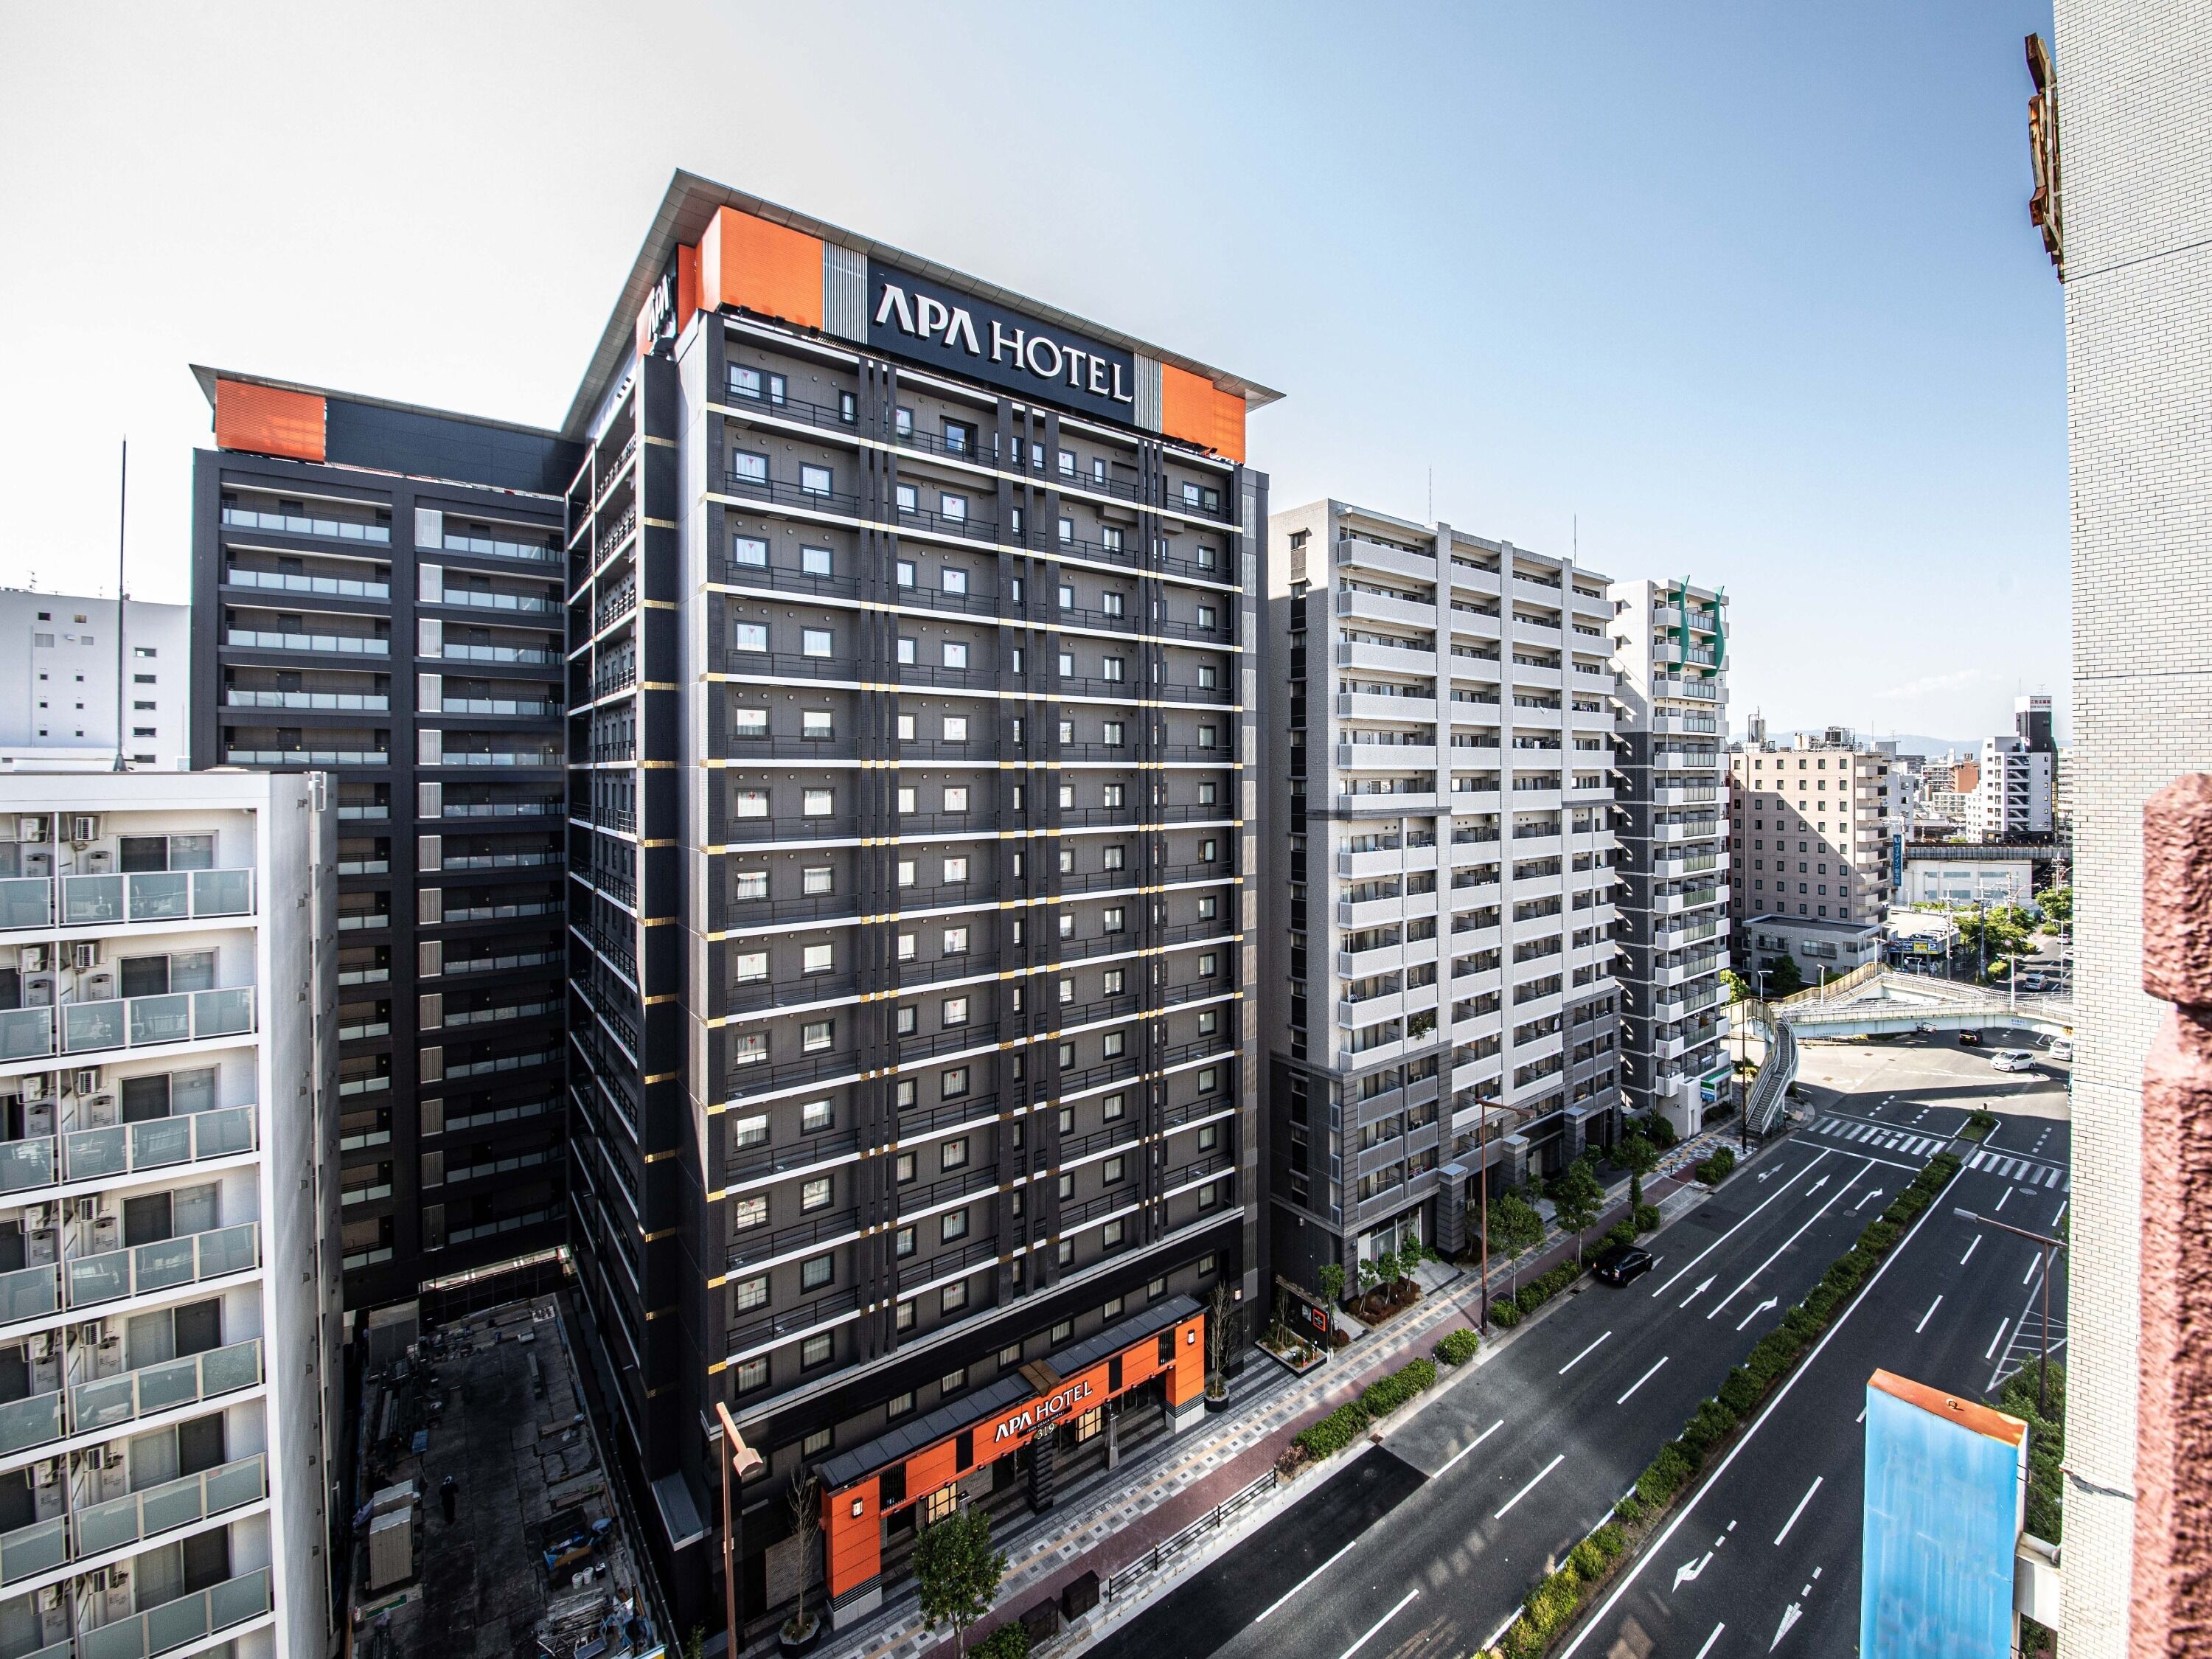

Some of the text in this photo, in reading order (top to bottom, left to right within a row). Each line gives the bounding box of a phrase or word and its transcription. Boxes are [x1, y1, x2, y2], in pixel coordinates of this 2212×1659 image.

[875, 282, 1133, 403] APA HOTEL
[1928, 943, 1937, 951] P
[995, 1381, 1093, 1442] APA HOTEL
[1037, 1422, 1054, 1440] 319
